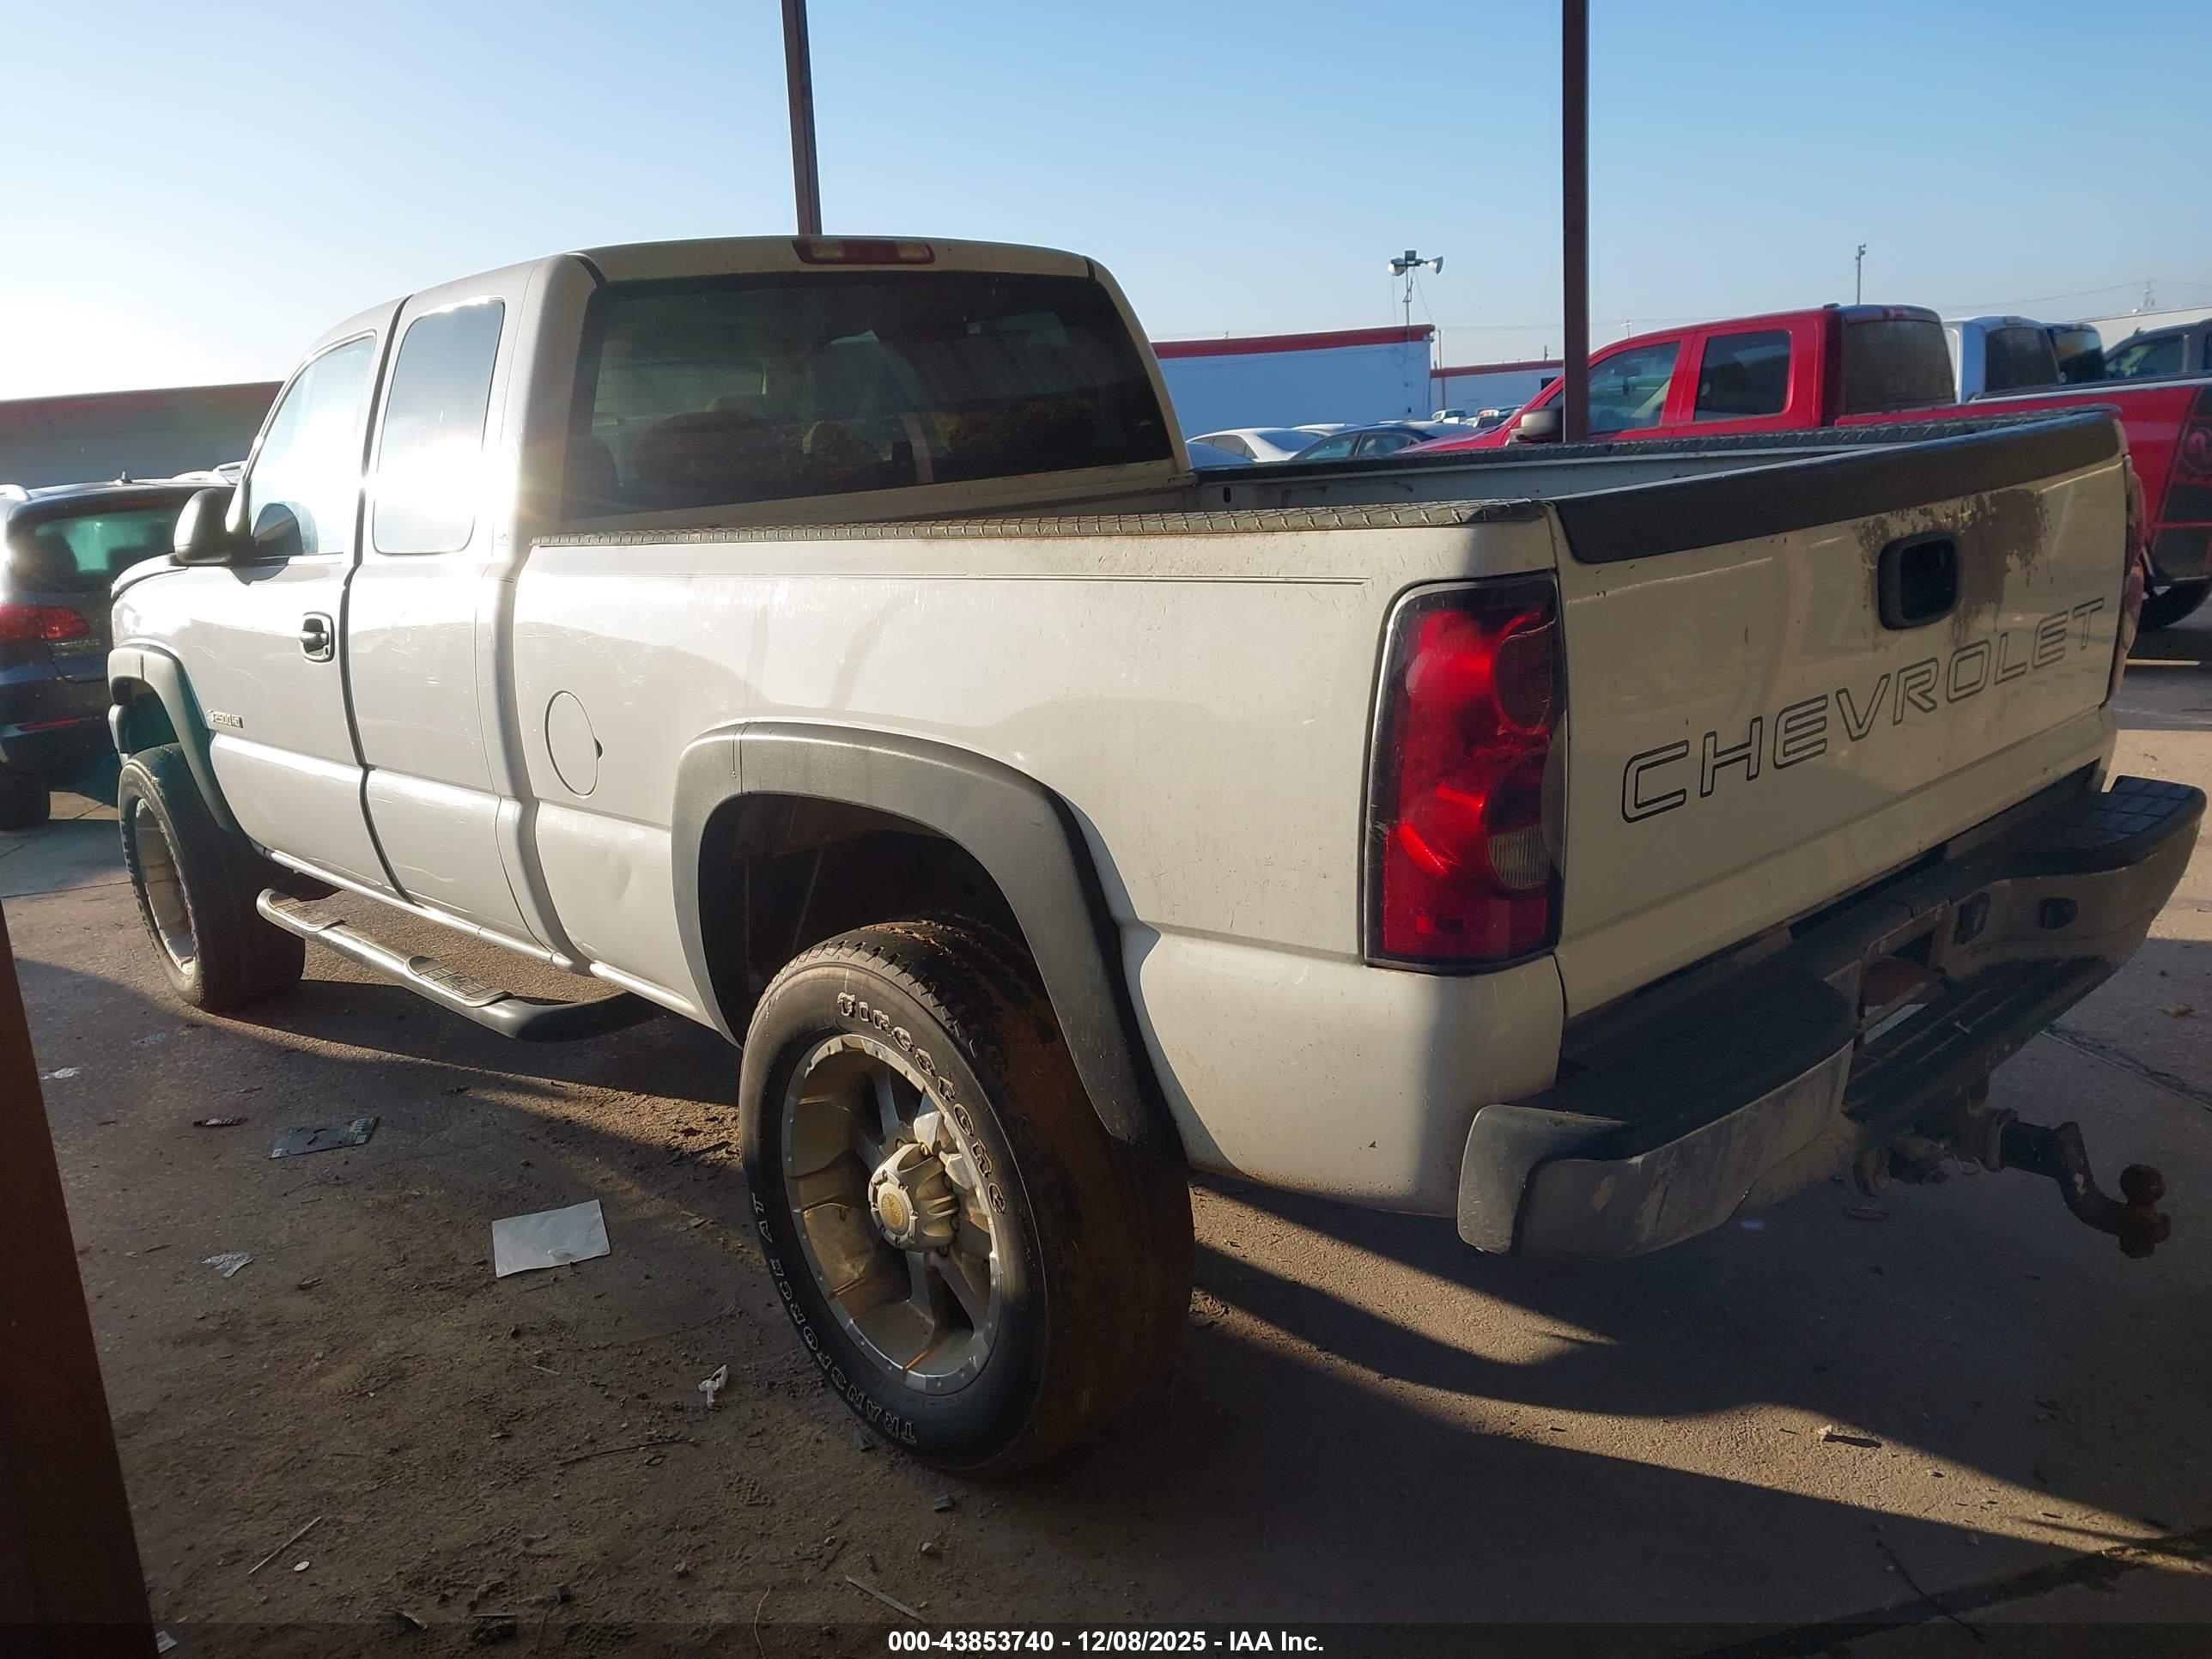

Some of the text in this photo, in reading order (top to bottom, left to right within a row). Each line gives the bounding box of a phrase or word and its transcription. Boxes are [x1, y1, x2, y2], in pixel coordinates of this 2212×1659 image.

[1620, 596, 2105, 823] CHEVROLET
[750, 1191, 919, 1444] TRANSFORCE AT
